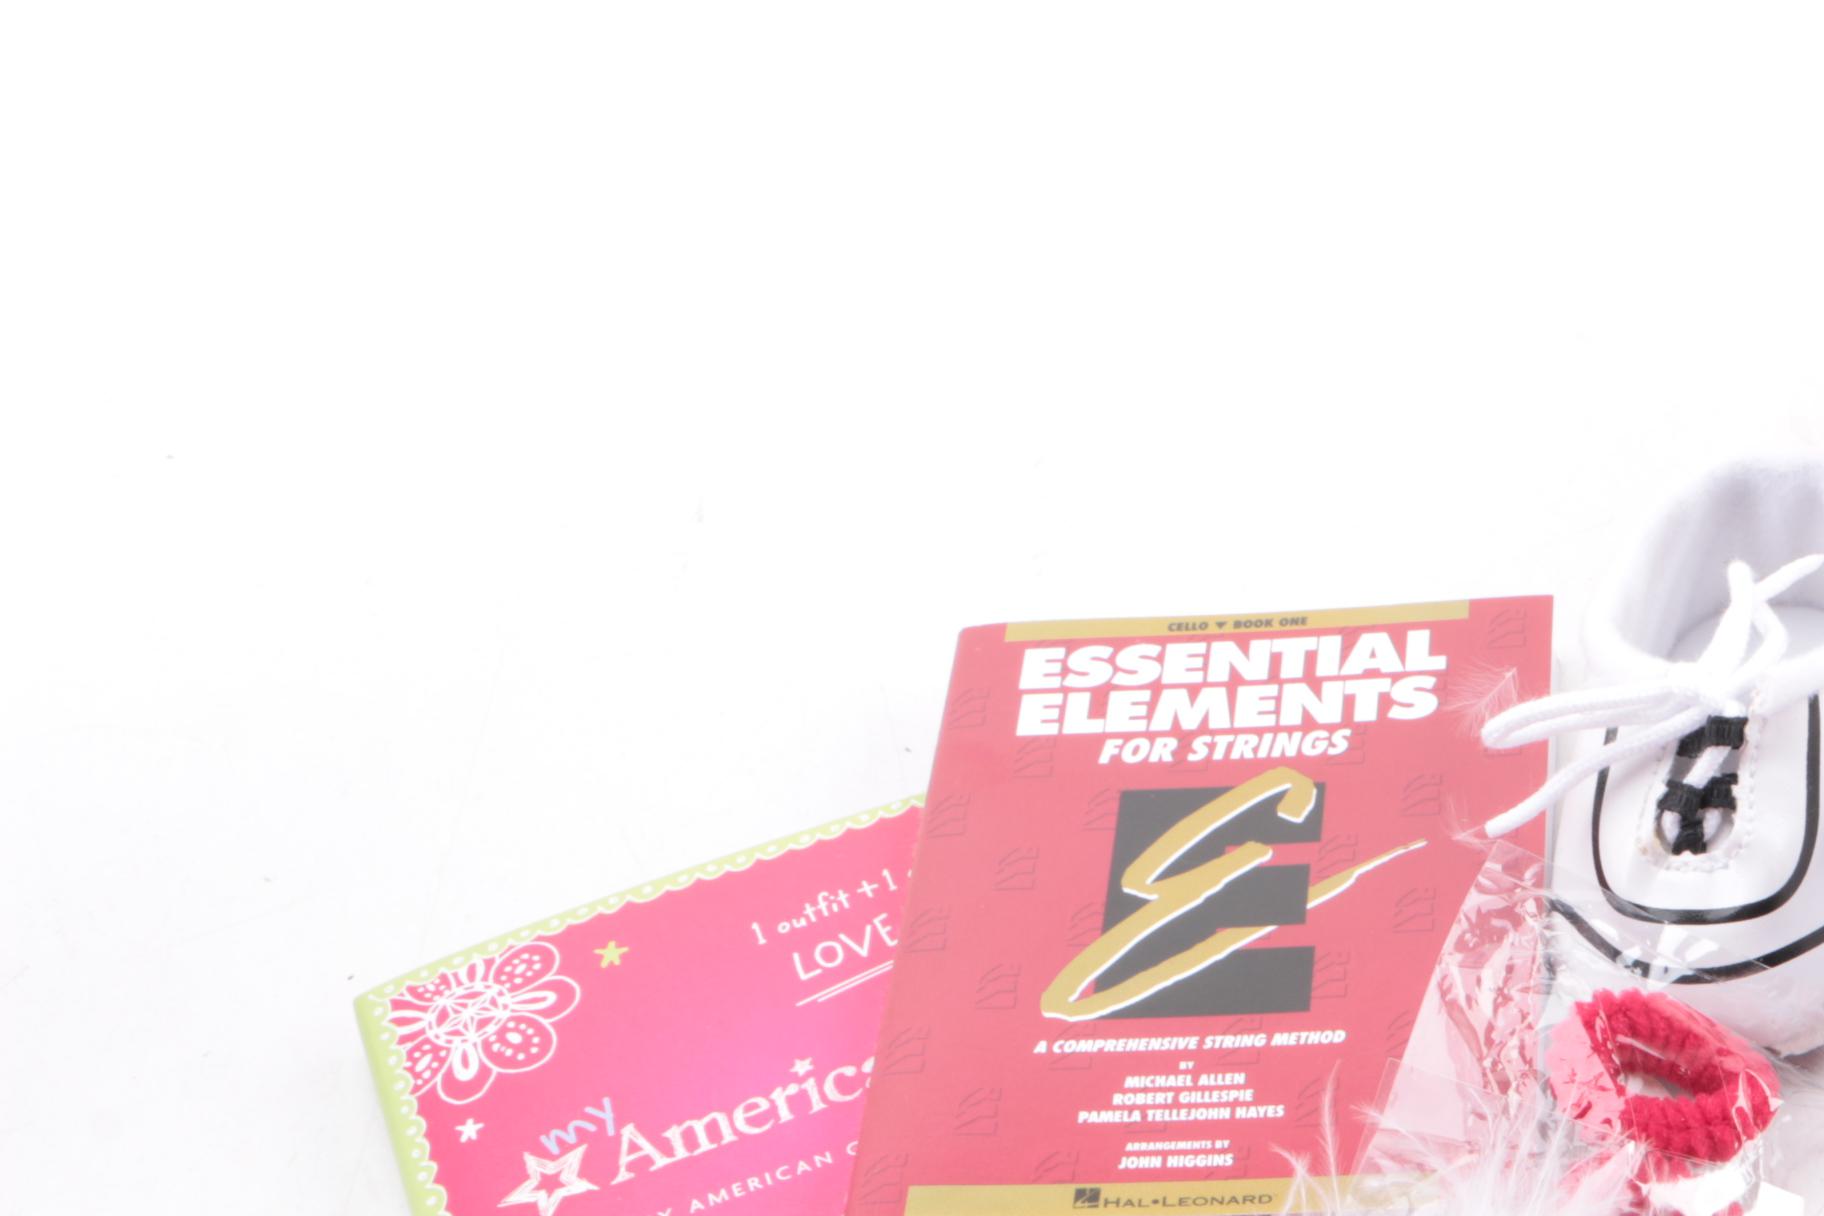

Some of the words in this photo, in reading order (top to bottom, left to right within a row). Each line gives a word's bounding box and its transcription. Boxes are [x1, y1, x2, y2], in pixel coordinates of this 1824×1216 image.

[1167, 621, 1209, 632] CELLO
[1233, 618, 1274, 630] BOOK
[1279, 616, 1308, 627] ONE
[1017, 629, 1448, 690] ESSENTIAL
[1015, 675, 1439, 736] ELEMENTS
[1098, 738, 1177, 765] FOR
[1187, 728, 1351, 762] STRINGS
[776, 889, 850, 934] outfit
[792, 912, 899, 981] LOVE
[1033, 1040, 1047, 1054] A
[1052, 1036, 1199, 1054] COMPREHENSIVE
[1203, 1034, 1267, 1050] STRING
[1271, 1030, 1347, 1046] METHOD
[1179, 1061, 1195, 1071] BY
[1124, 1075, 1194, 1089] MICHAEL
[1198, 1073, 1246, 1087] ALLEN
[1112, 1092, 1174, 1106] ROBERT
[1178, 1089, 1254, 1104] GILLESPIE
[540, 1096, 616, 1156] my
[1077, 1109, 1141, 1124] PAMELA
[1147, 1107, 1231, 1122] TELLEJOHN
[1235, 1104, 1285, 1119] HAYES
[1125, 1141, 1212, 1152] ARRANGEMENTS
[1215, 1139, 1231, 1150] BY
[1118, 1155, 1162, 1170] JOHN
[1167, 1153, 1234, 1169] HIGGINS
[688, 1149, 834, 1215] AMERICAN
